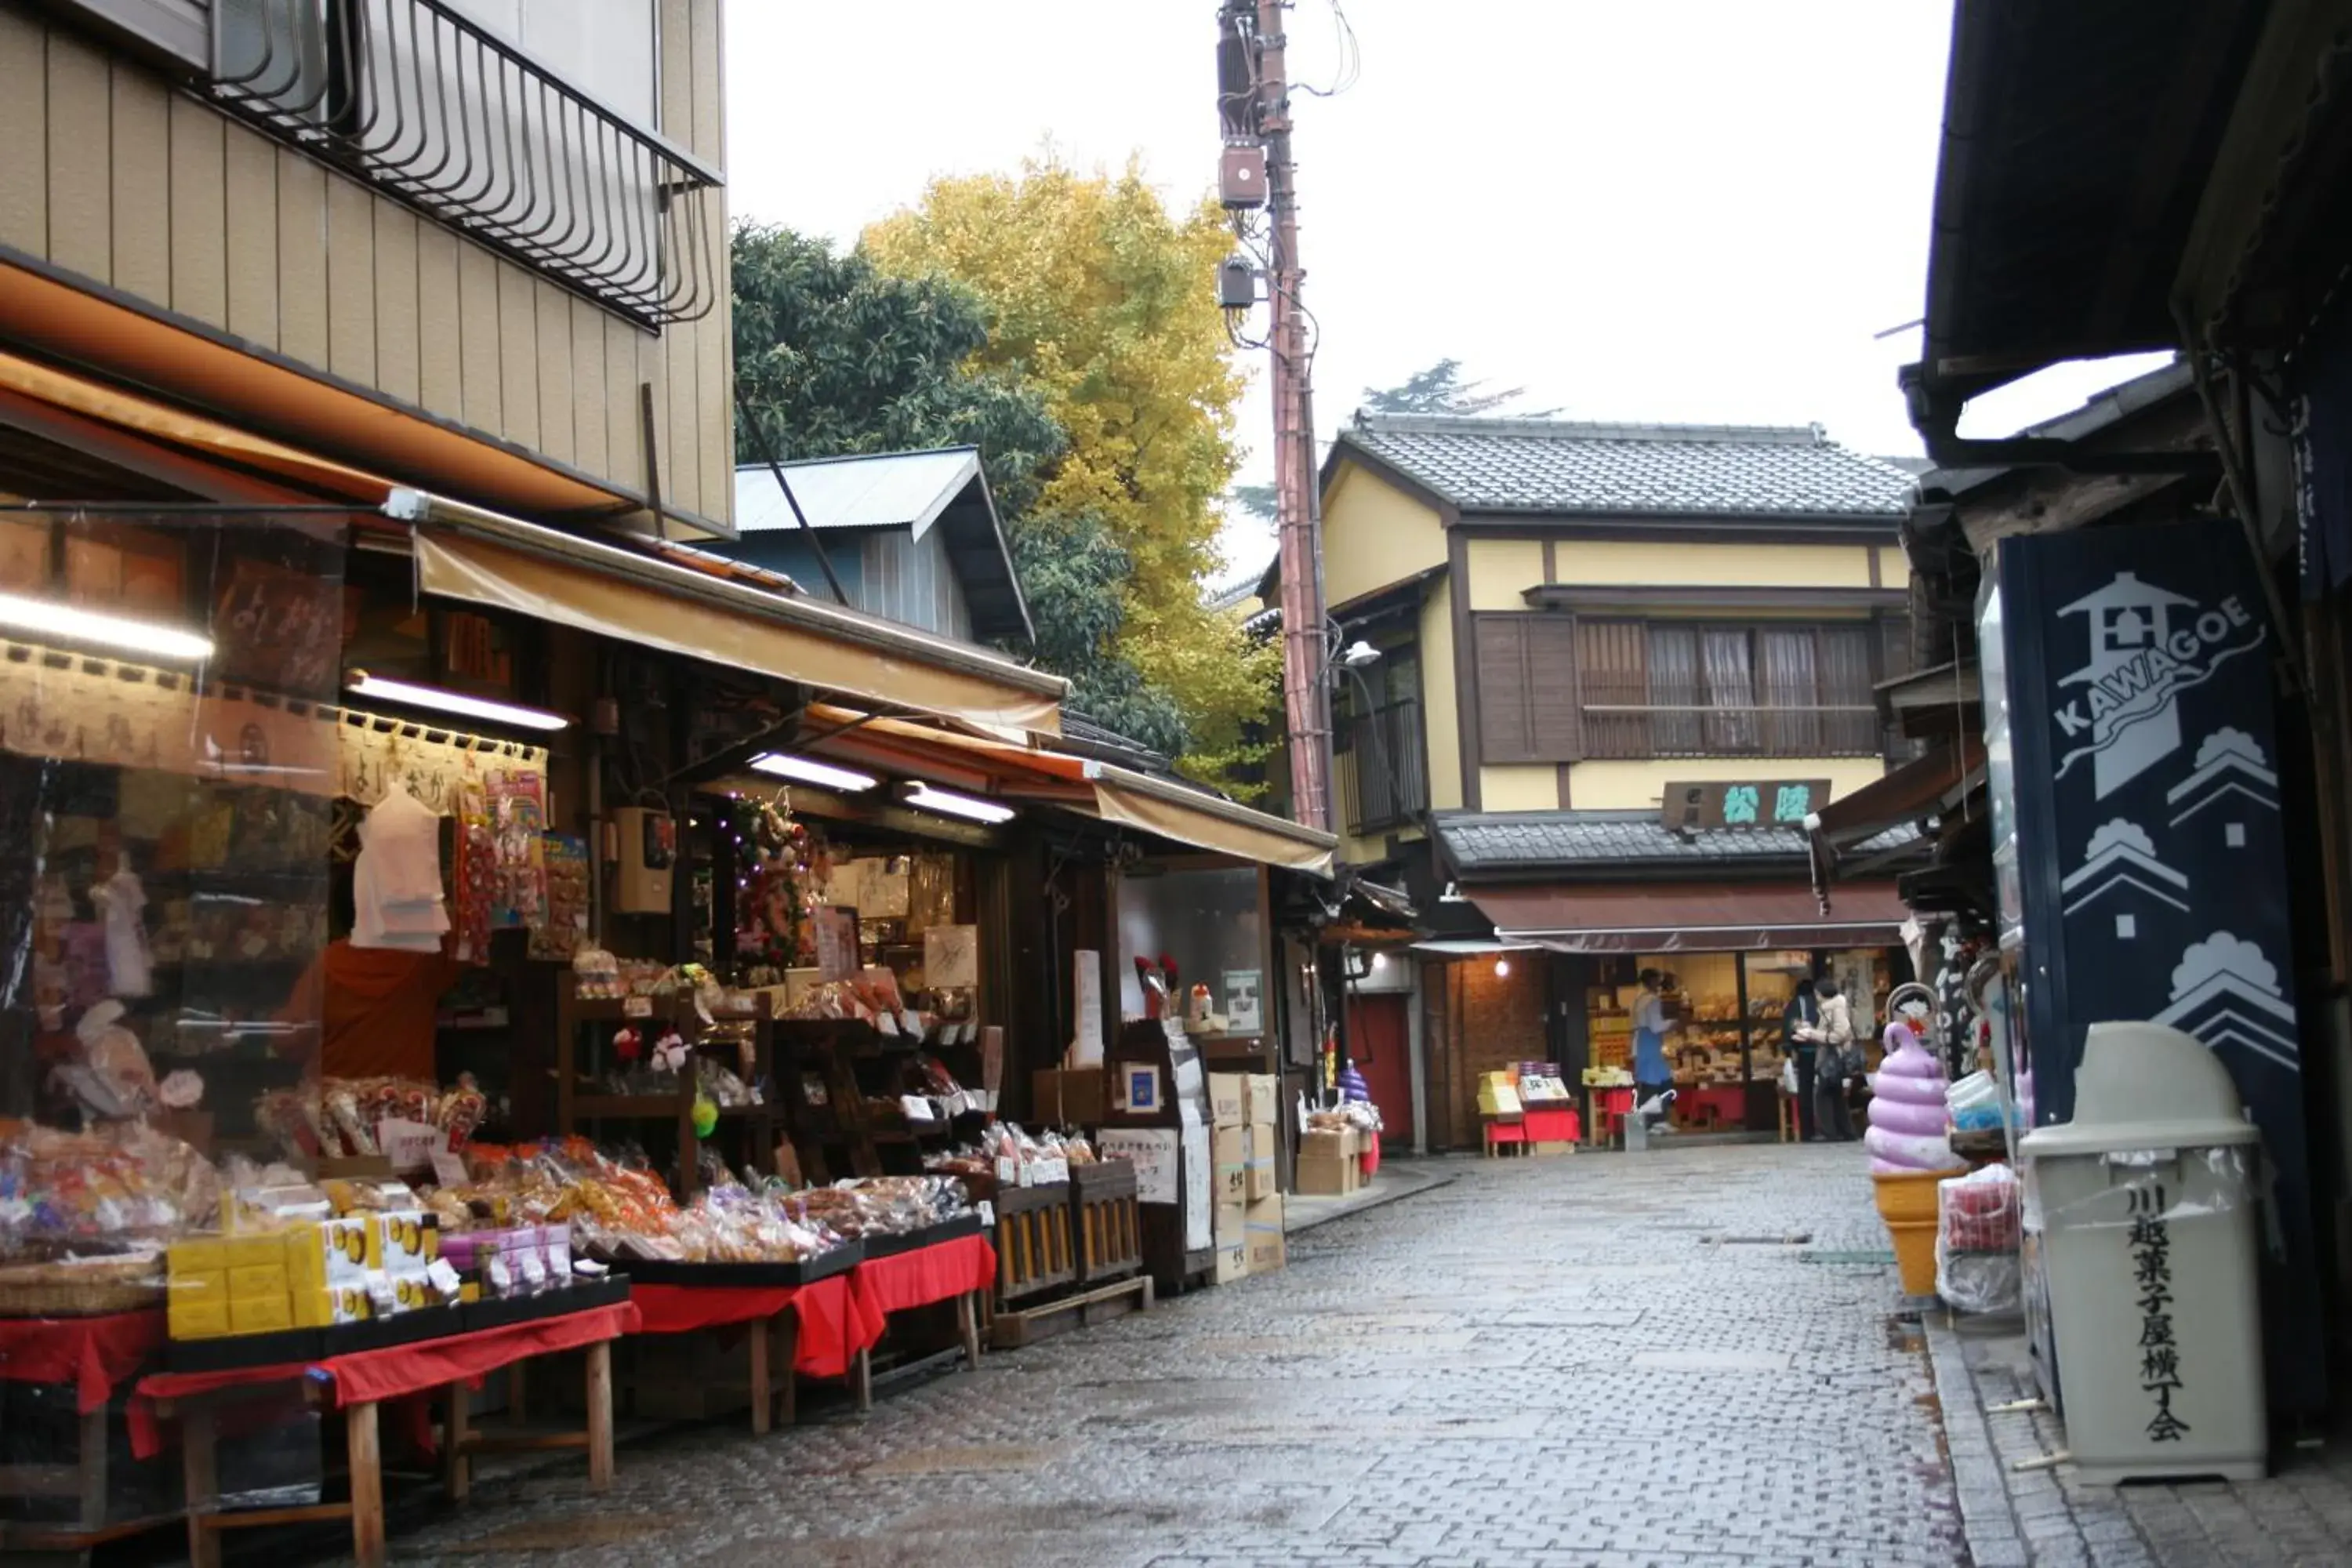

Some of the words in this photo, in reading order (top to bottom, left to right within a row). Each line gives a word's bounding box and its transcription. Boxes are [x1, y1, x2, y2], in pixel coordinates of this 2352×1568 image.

[2054, 594, 2252, 737] KAWAGOE
[2126, 1185, 2191, 1442] 川越菓子屋横丁会
